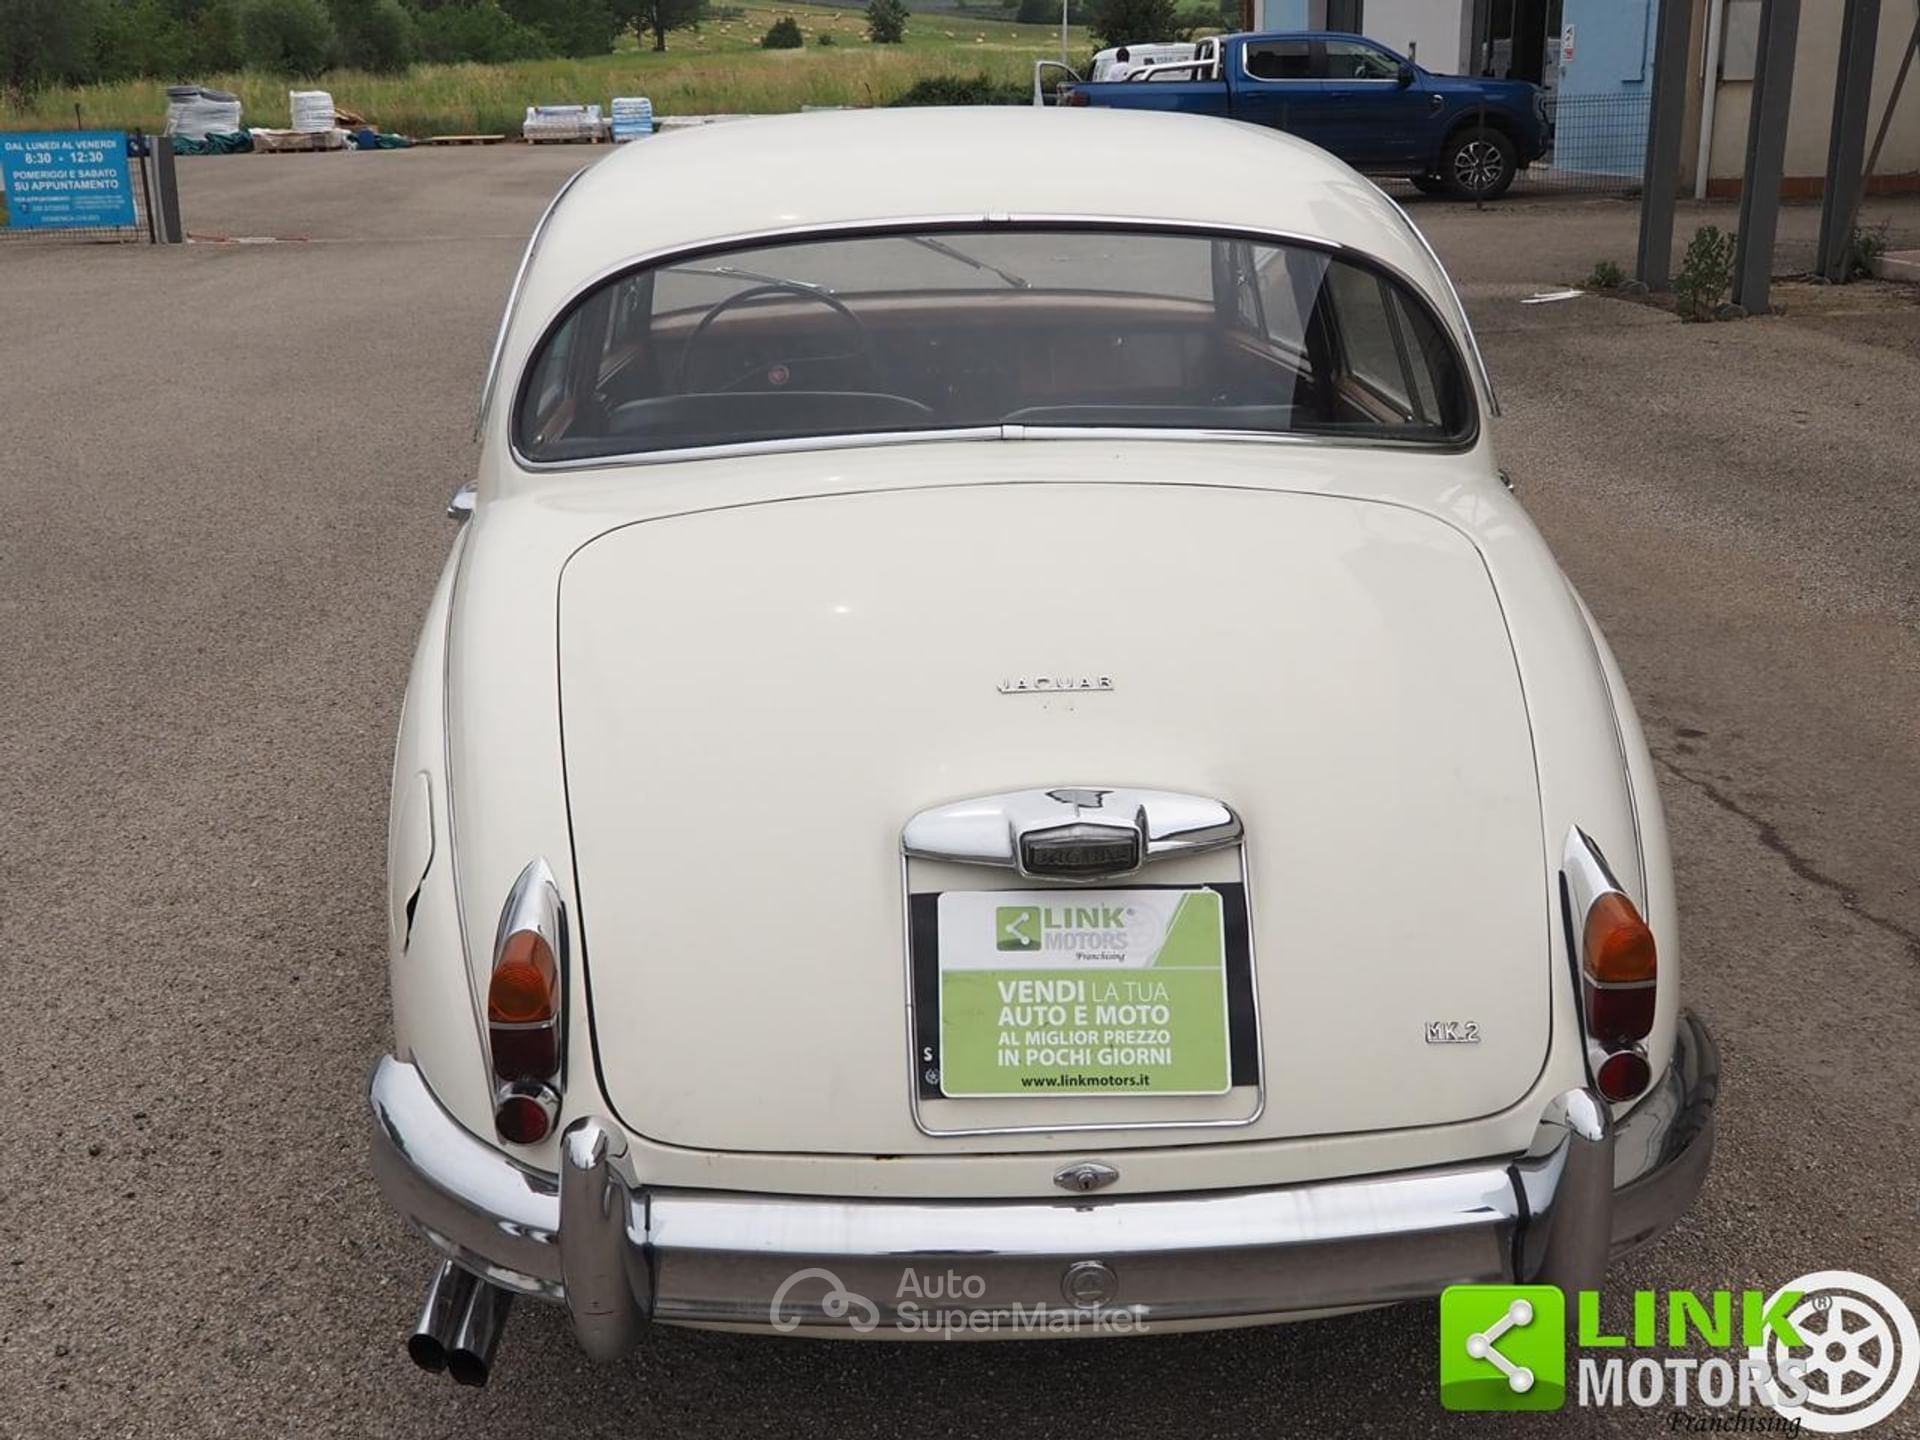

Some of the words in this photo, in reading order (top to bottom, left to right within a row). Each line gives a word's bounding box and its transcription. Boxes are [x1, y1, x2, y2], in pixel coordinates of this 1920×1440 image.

[4, 142, 25, 151] DAL
[61, 140, 75, 150] AL
[25, 152, 52, 164] 8:30
[70, 151, 104, 163] 12:30
[13, 169, 67, 180] POMERIGGI
[69, 169, 75, 178] E
[78, 168, 117, 178] SABATO
[14, 181, 29, 191] SU
[31, 180, 119, 191] APPUNTAMENTO
[997, 676, 1114, 694] JAGUAR
[1044, 907, 1125, 929] LINK
[1044, 932, 1128, 951] MOTORS
[1075, 951, 1126, 962] Franchising
[998, 979, 1085, 1003] VENDI
[1092, 981, 1119, 1002] LA
[1124, 981, 1169, 1002] TUA
[998, 1005, 1067, 1026] AUTO
[1074, 1005, 1089, 1026] E
[1096, 1004, 1171, 1025] MOTO
[998, 1031, 1020, 1046] AL
[1025, 1030, 1099, 1045] MIGLIOR
[1104, 1029, 1171, 1045] PREZZO
[923, 1046, 933, 1062] S
[998, 1049, 1020, 1067] IN
[1026, 1048, 1091, 1067] POCHI
[1097, 1047, 1172, 1066] GIORNI
[1021, 1073, 1151, 1088] www.linkmotors.it
